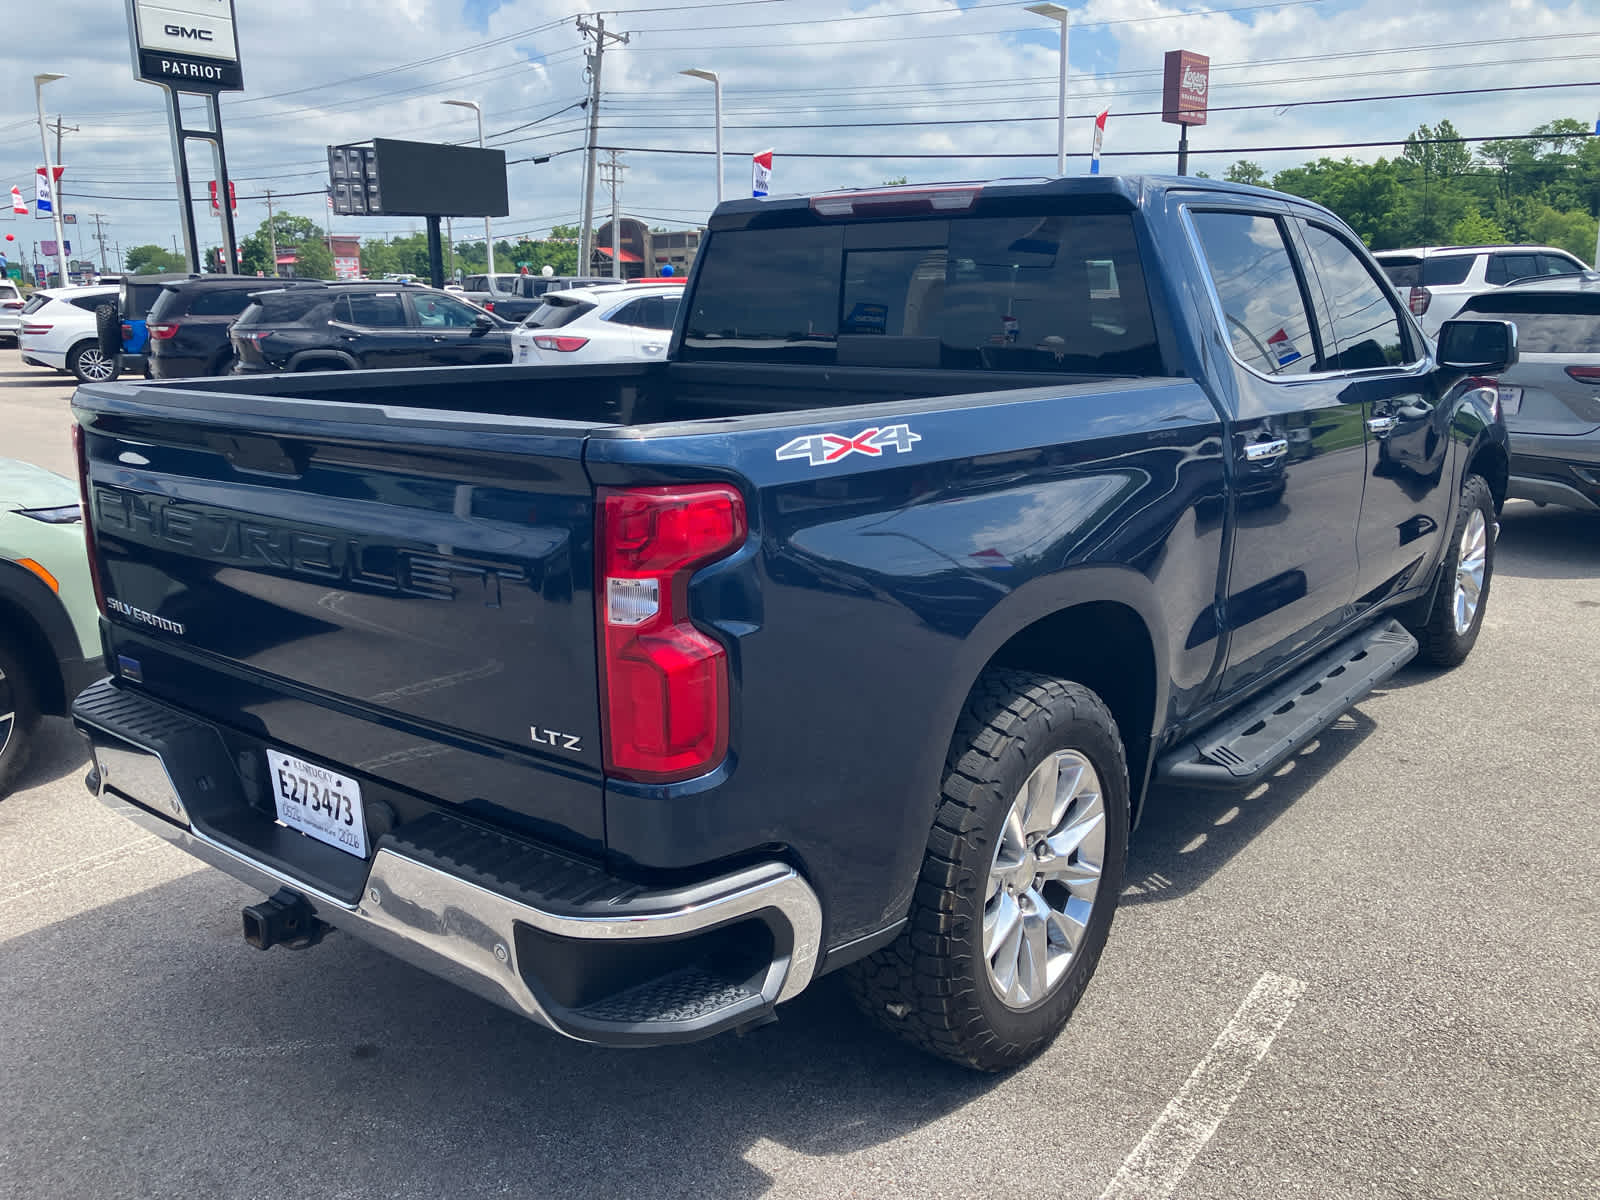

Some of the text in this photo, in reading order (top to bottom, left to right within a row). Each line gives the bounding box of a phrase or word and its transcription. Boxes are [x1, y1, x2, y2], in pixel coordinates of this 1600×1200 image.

[164, 24, 213, 41] GMC
[162, 60, 222, 79] PATRIOT
[96, 488, 525, 609] CHEVROLET
[106, 596, 185, 635] SILVERADO
[530, 726, 582, 751] LTZ
[293, 760, 333, 783] KENTUCKY
[278, 768, 354, 827] E273473
